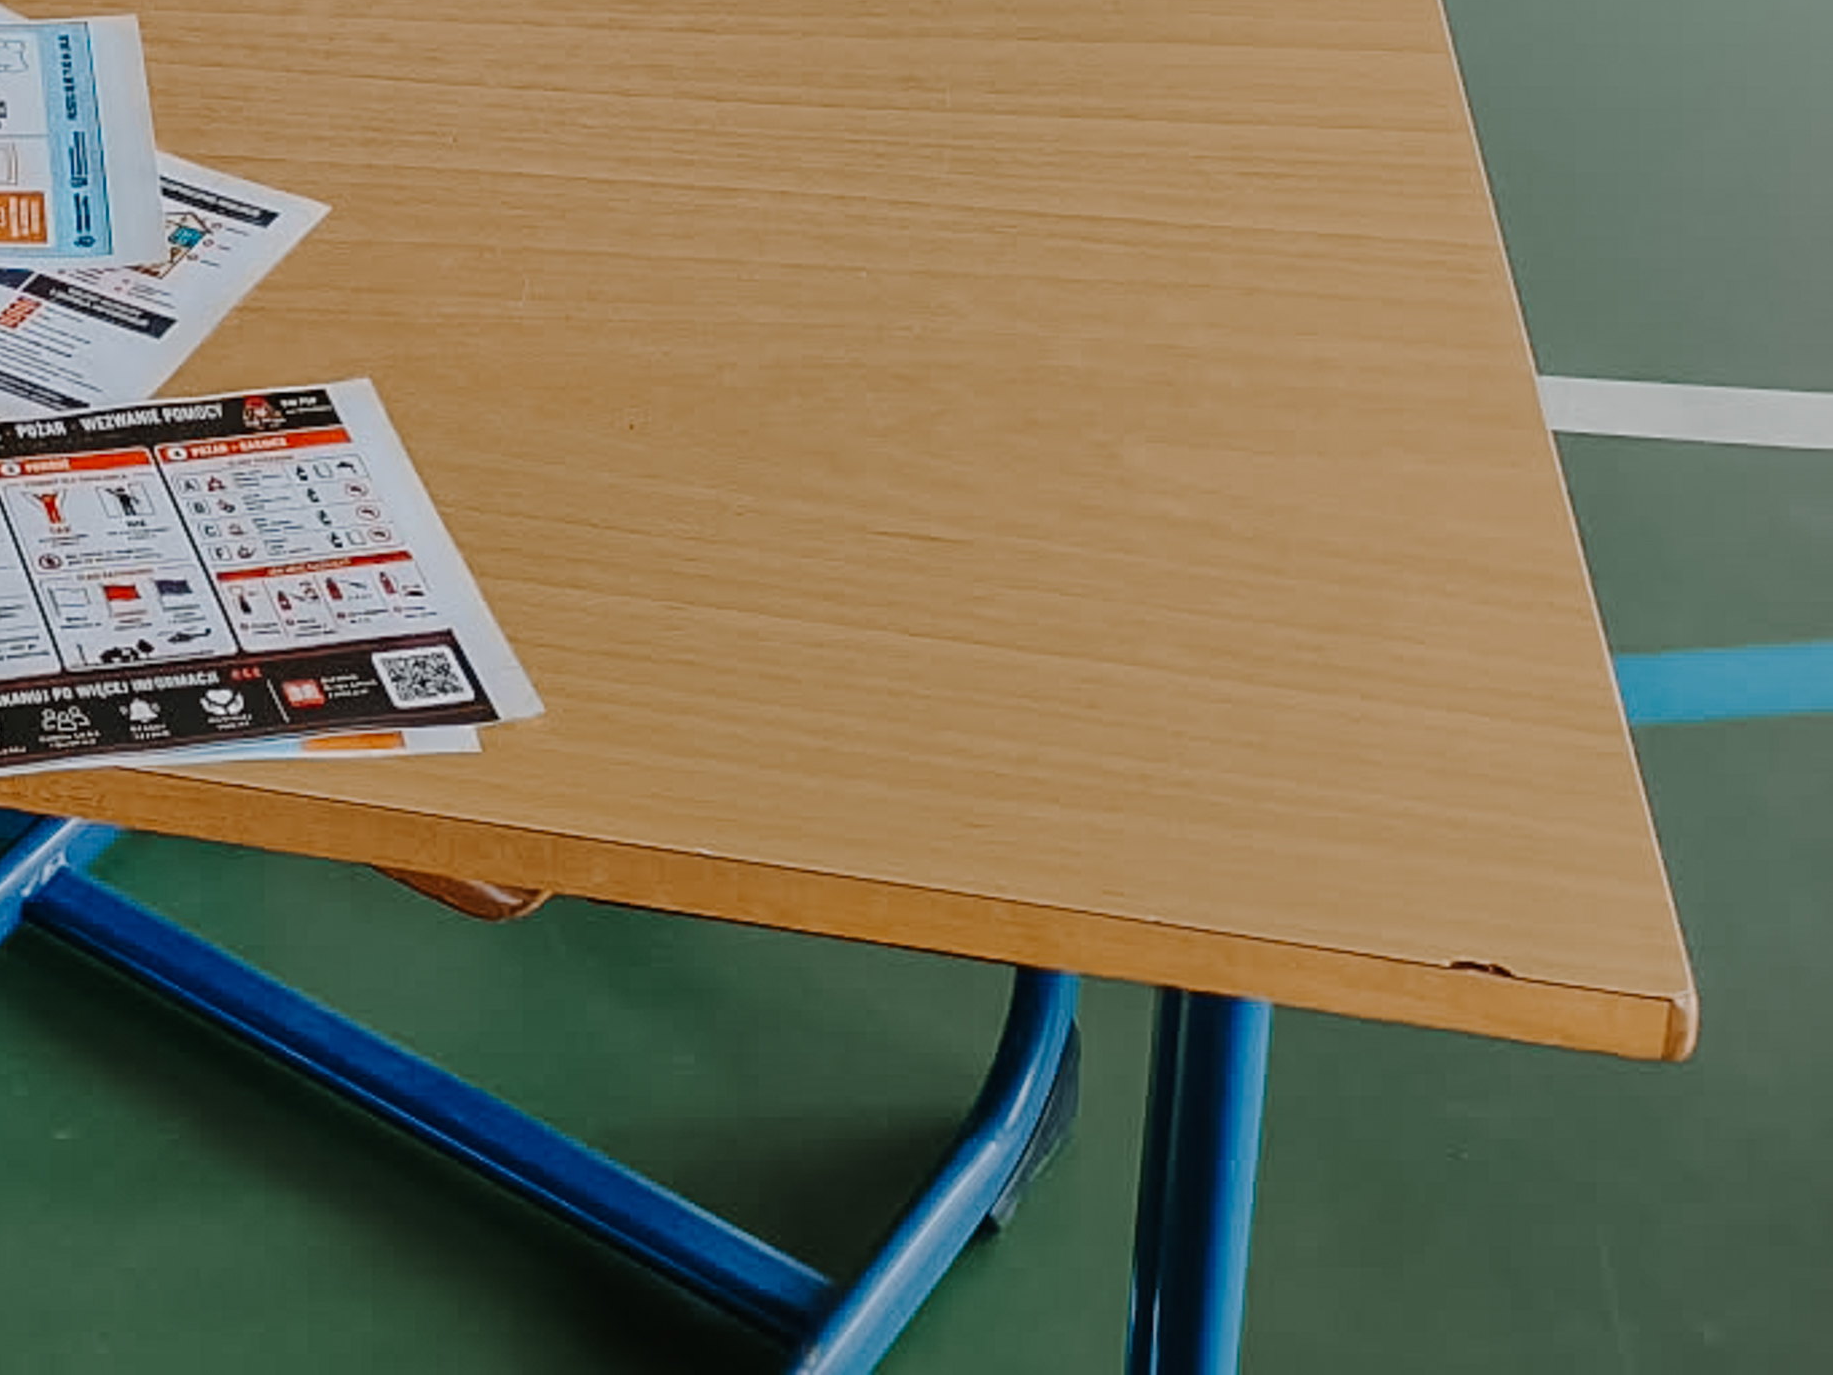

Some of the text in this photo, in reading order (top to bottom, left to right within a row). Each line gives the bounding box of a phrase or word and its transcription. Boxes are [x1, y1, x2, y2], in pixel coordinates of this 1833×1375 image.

[14, 417, 68, 441] POŻAR
[80, 408, 163, 434] WEZWANIE
[163, 401, 224, 426] POMOCY
[53, 686, 73, 703] PO
[76, 680, 129, 702] WIĘCEJ
[131, 670, 220, 693] INFORMACJI
